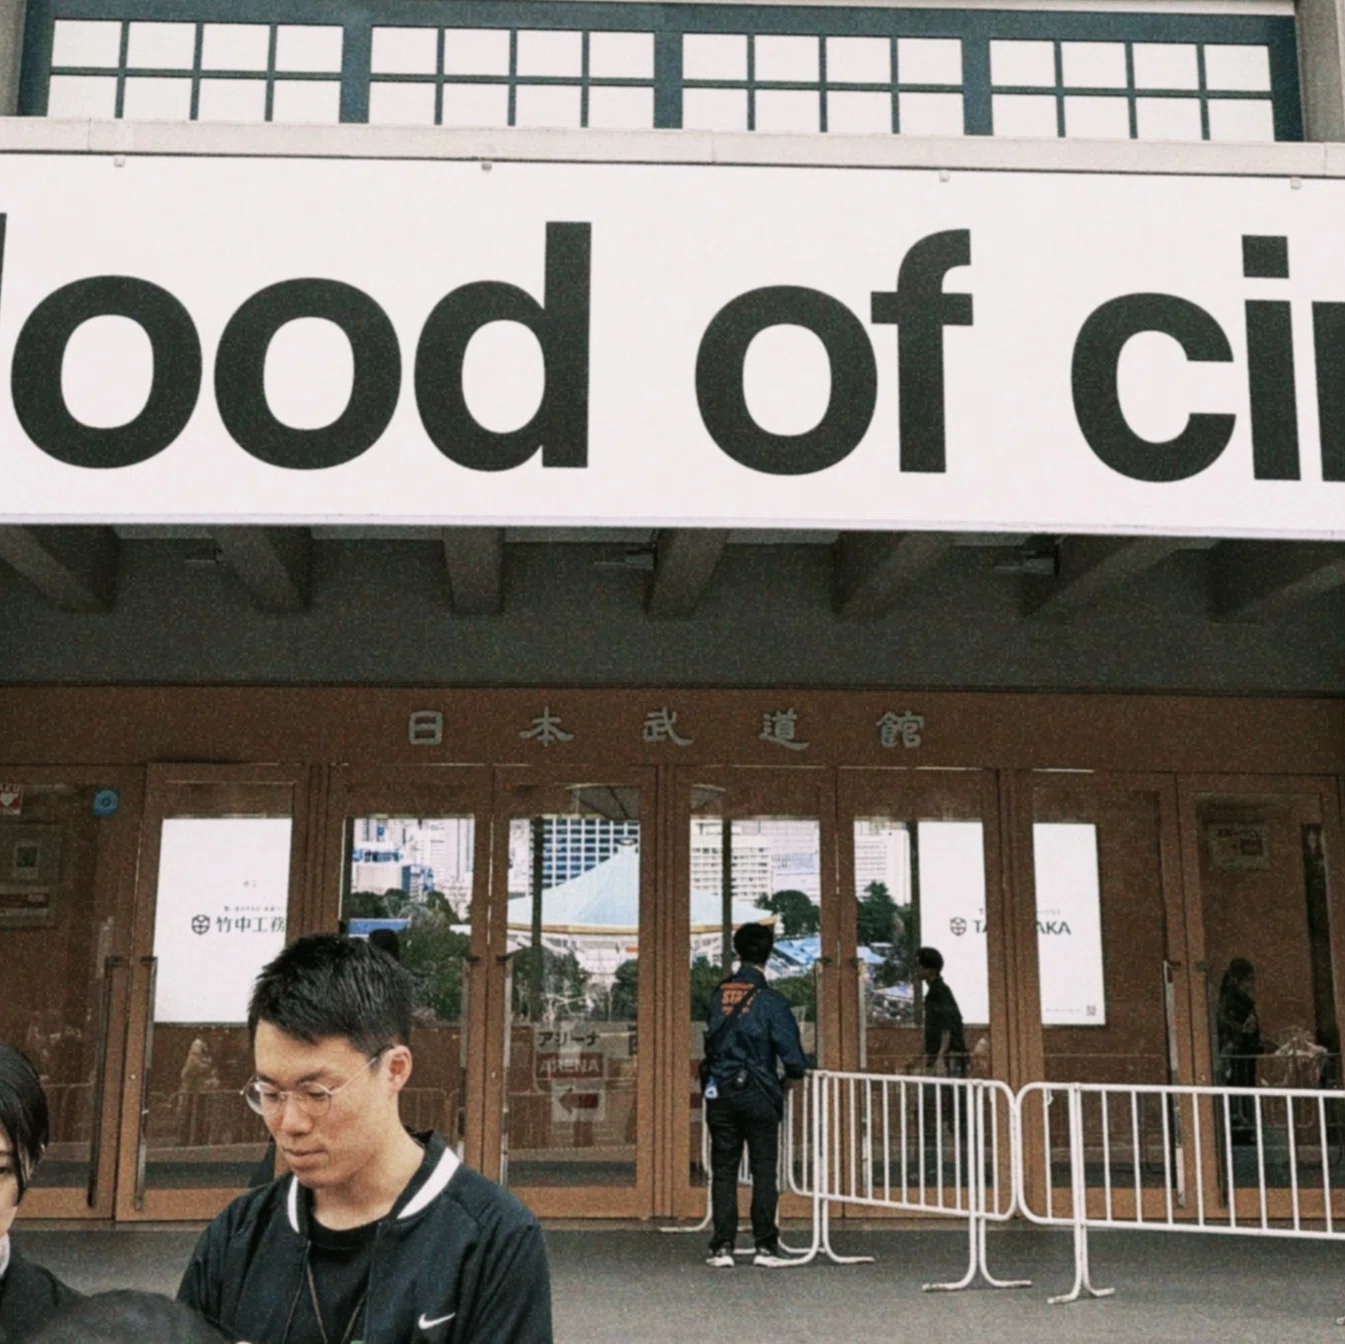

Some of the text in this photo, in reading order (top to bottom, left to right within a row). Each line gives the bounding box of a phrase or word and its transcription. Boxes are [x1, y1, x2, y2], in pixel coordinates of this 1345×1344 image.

[695, 229, 973, 476] of
[408, 706, 925, 750] 日本武道館
[538, 1031, 600, 1047] アリーナ
[540, 1058, 601, 1074] ARENA
